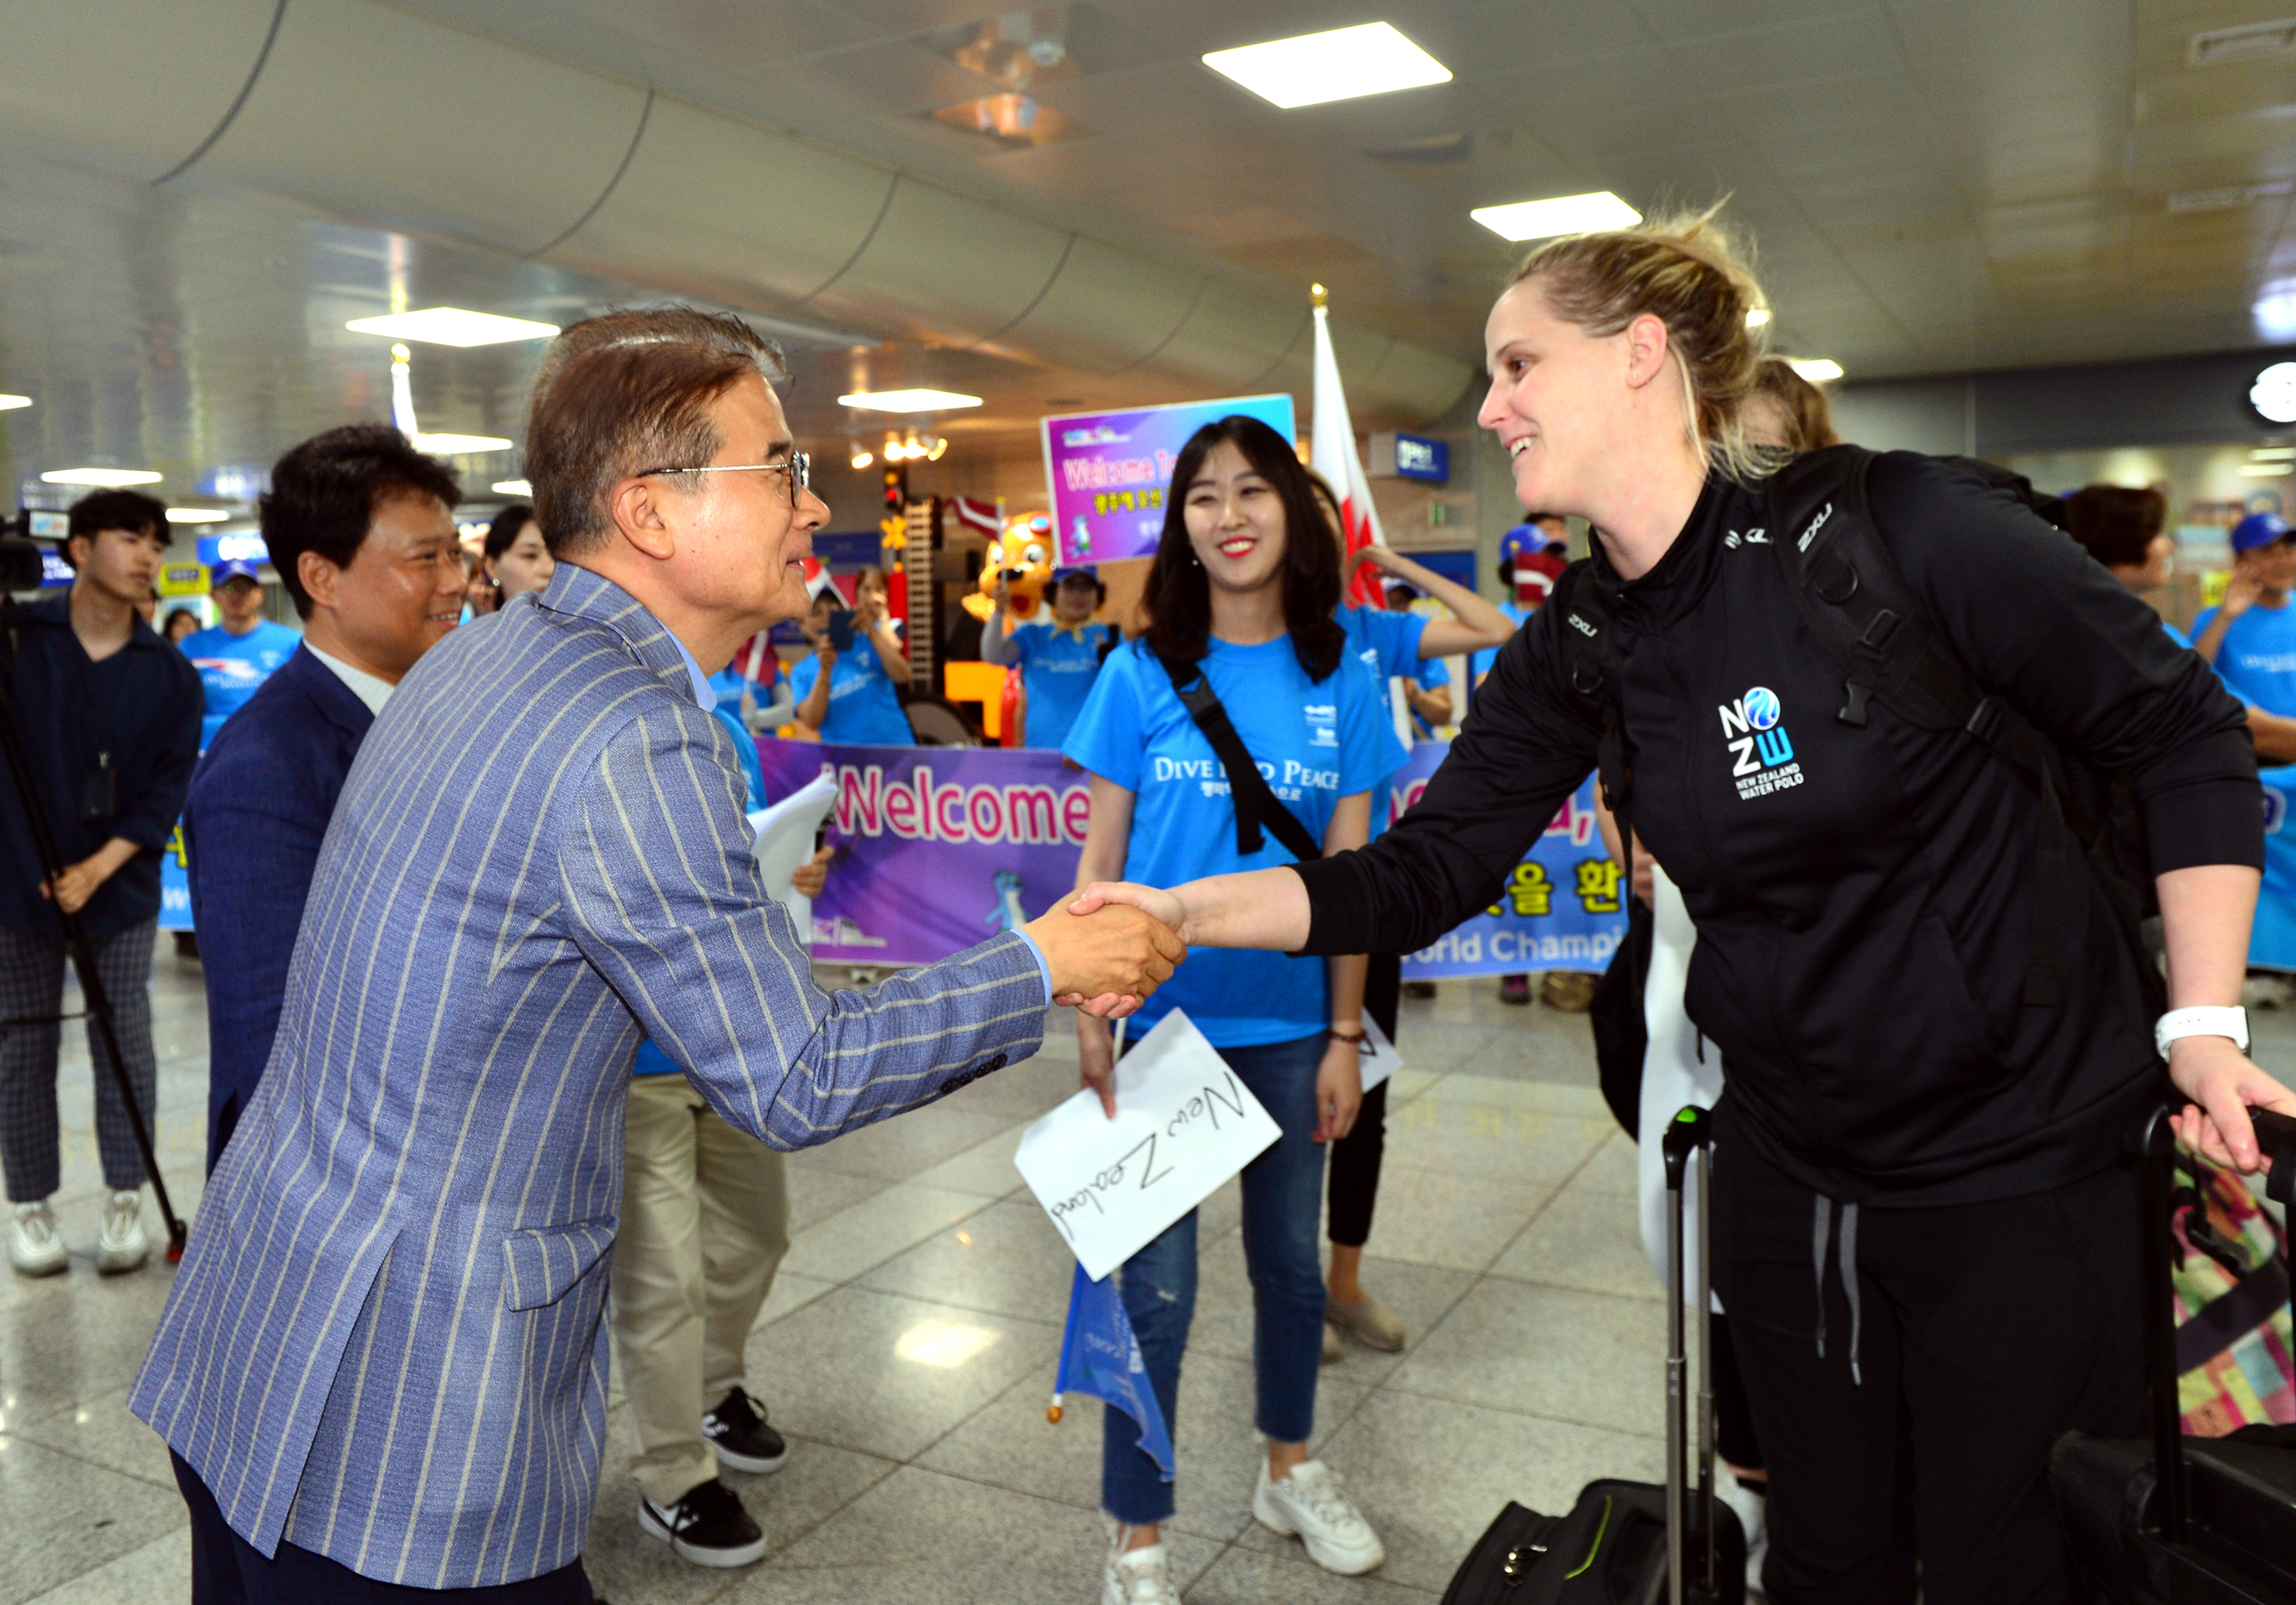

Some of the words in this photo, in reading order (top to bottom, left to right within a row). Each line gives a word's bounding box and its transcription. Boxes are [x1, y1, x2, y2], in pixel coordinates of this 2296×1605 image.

[1063, 456, 1154, 490] Welcome
[1154, 757, 1214, 781] DIVE
[1284, 759, 1339, 790] PEACE
[1736, 776, 1757, 791] NEW
[1756, 762, 1801, 785] ZEALAND
[1739, 780, 1775, 801] WATER
[1773, 772, 1805, 791] POLO
[823, 764, 1092, 846] Welcome
[1167, 1072, 1245, 1138] New
[1051, 1131, 1176, 1242] Zealand
